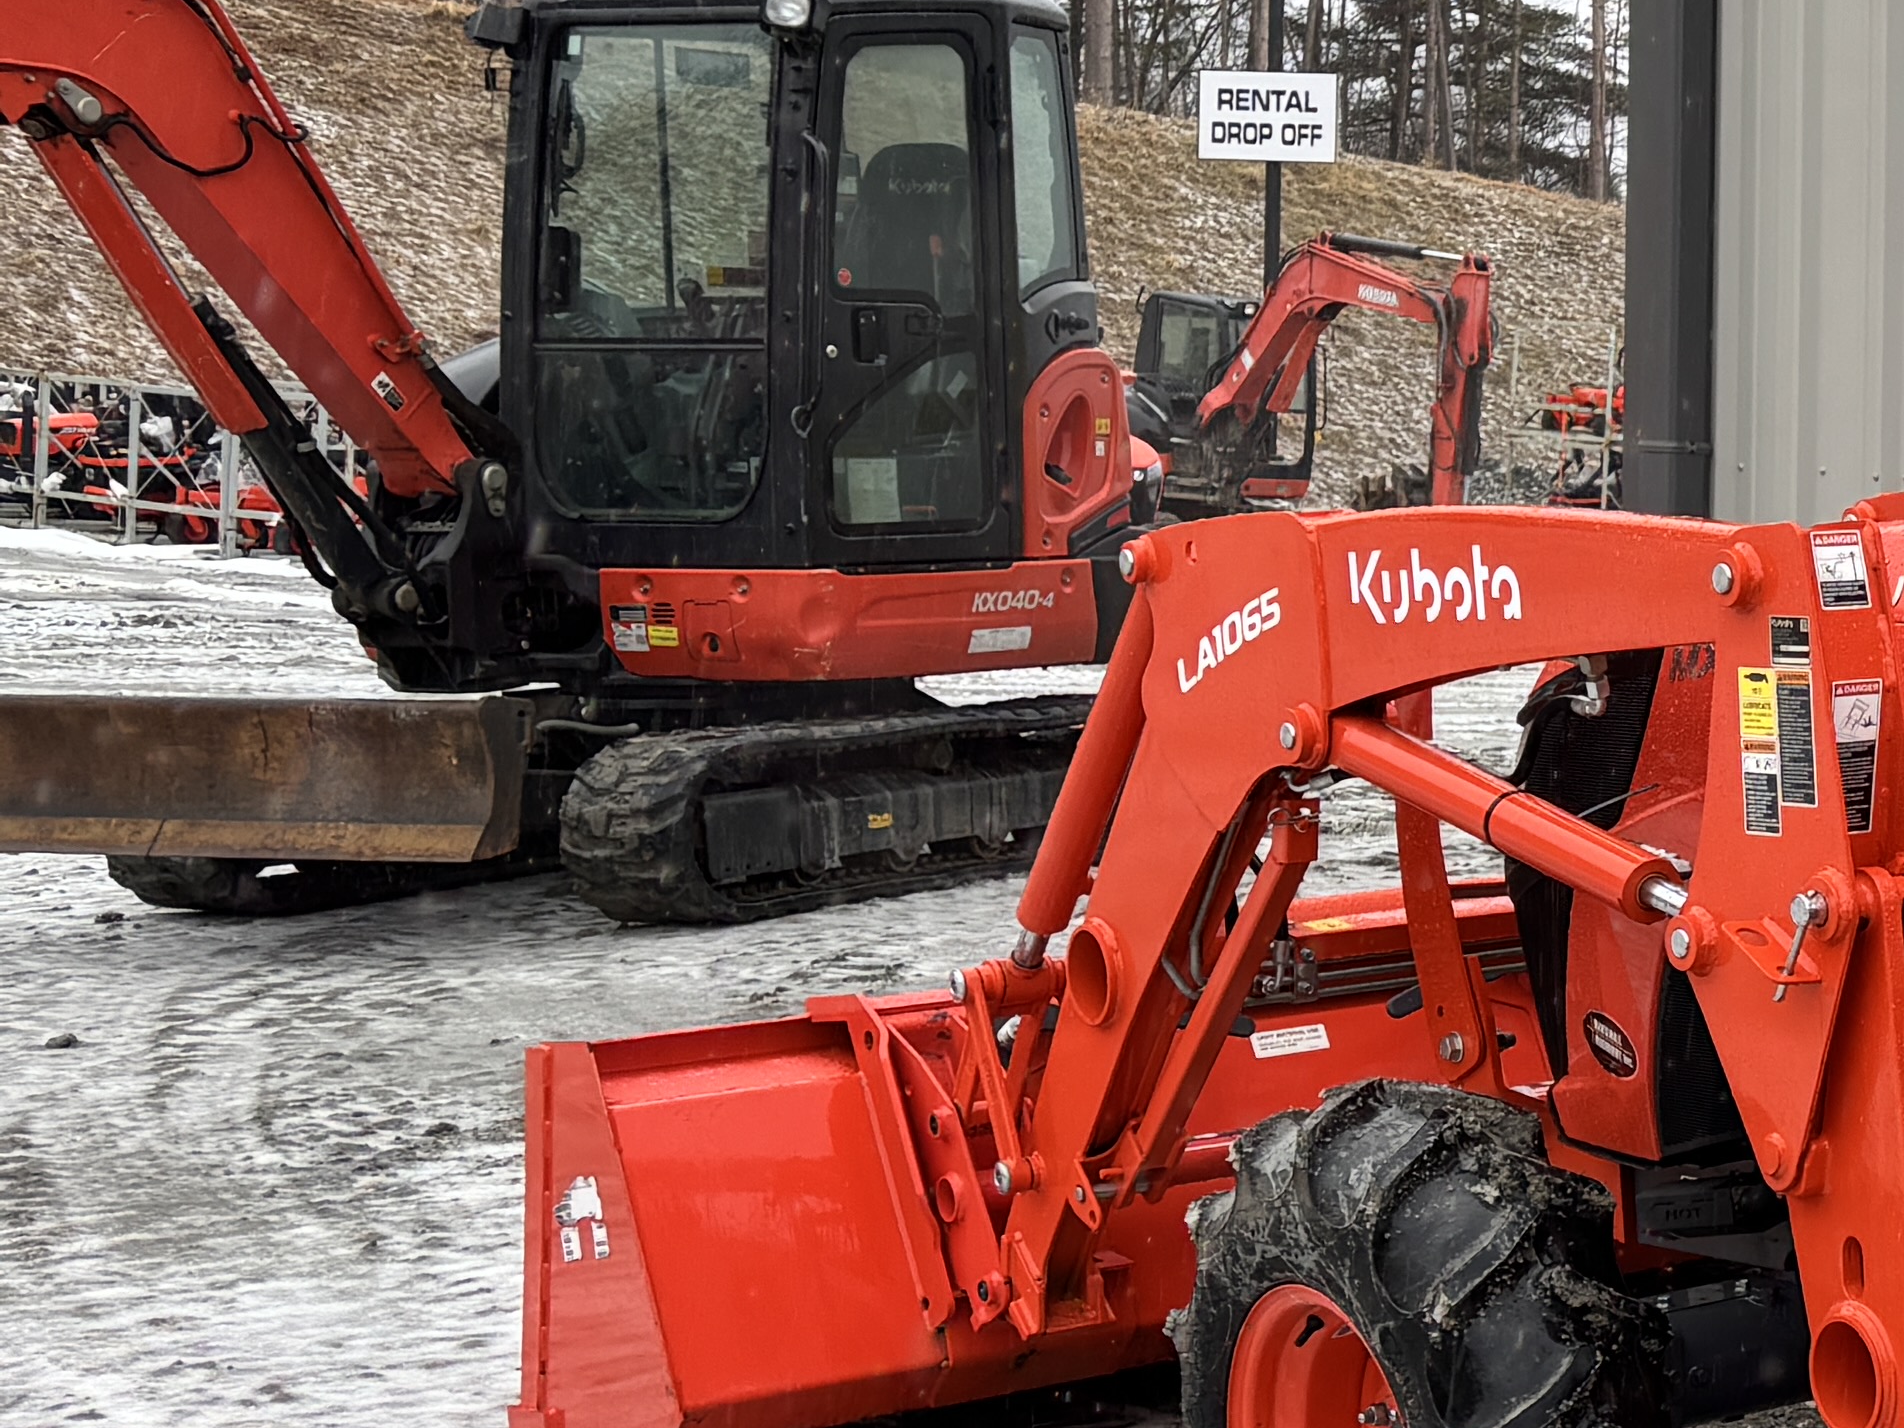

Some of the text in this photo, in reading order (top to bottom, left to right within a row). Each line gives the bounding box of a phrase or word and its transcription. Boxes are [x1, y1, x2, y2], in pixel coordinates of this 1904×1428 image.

[1217, 88, 1318, 113] RENTAL
[1211, 121, 1323, 147] DROP OFF
[1822, 534, 1858, 545] DANGER
[1348, 544, 1522, 624] Kubota
[971, 589, 1055, 613] KX040-4
[1176, 587, 1281, 693] LA1065
[1665, 1207, 1701, 1221] HOT
